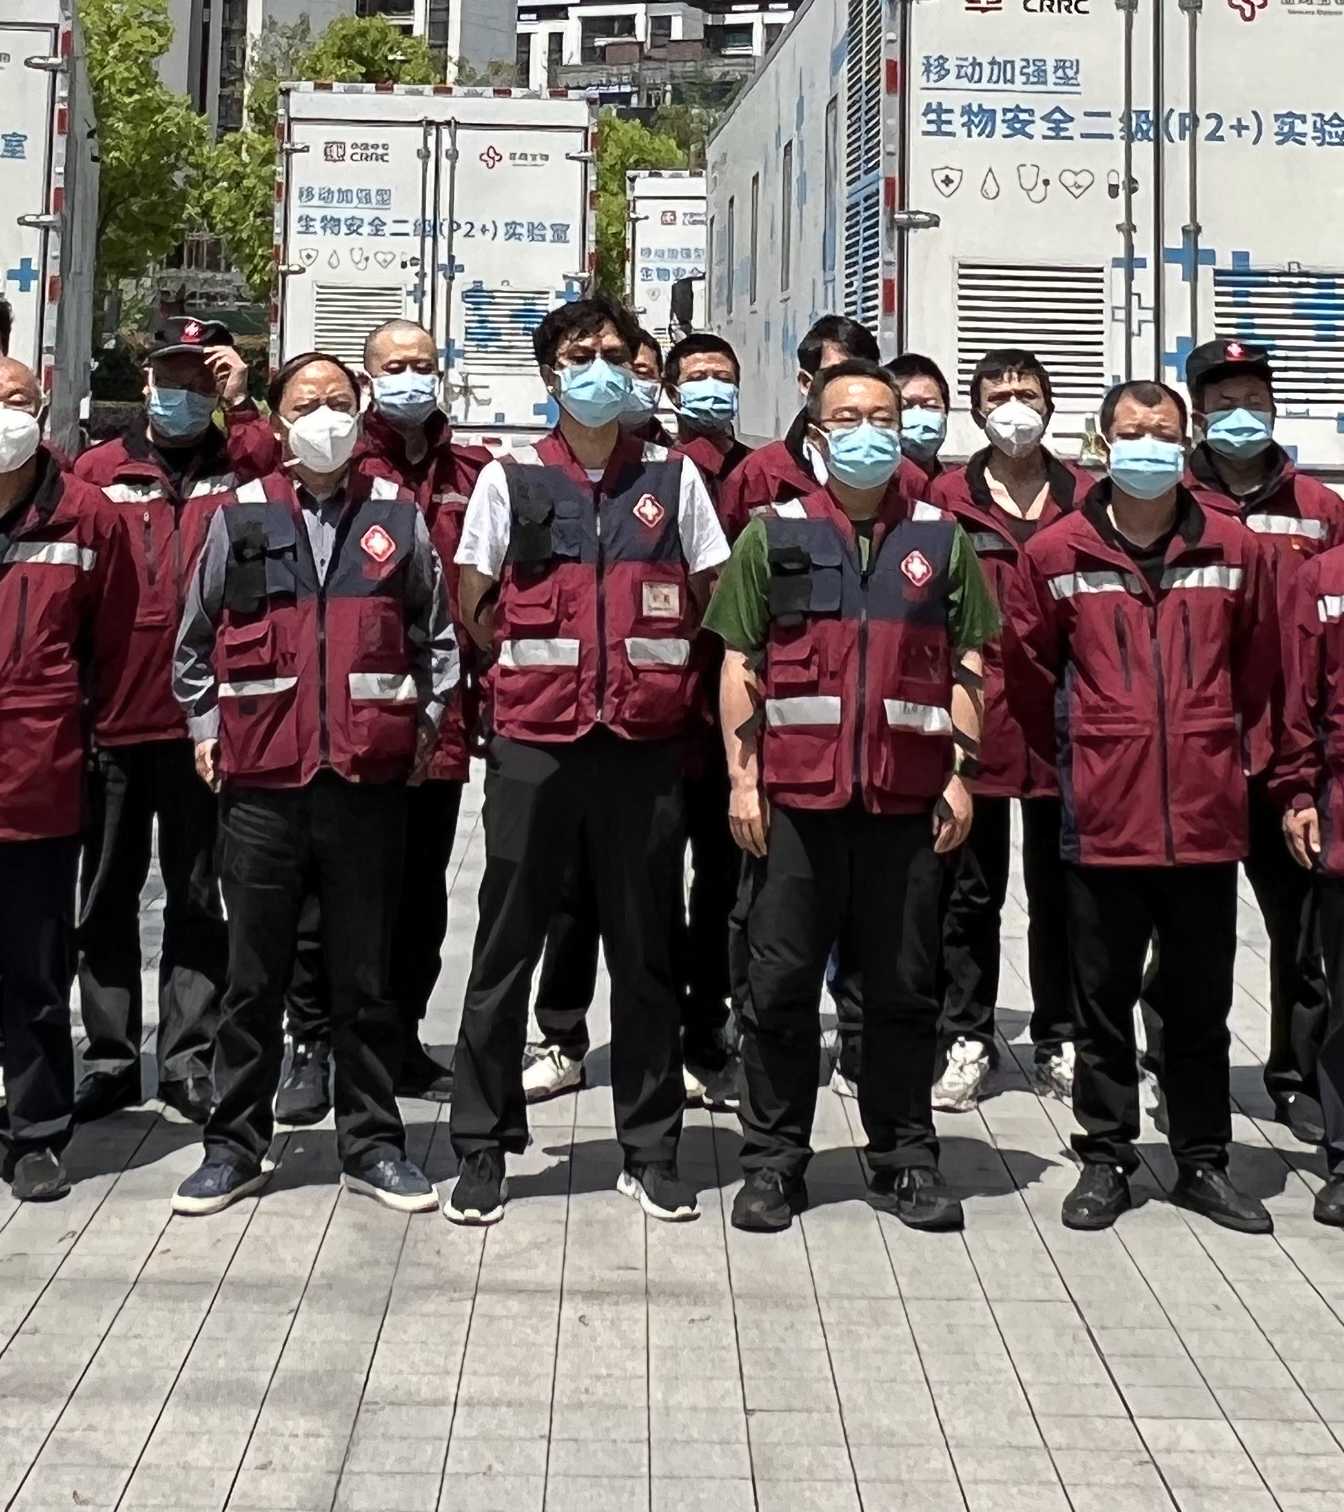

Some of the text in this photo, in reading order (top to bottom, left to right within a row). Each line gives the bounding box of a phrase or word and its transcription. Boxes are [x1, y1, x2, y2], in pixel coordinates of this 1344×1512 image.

[921, 54, 1081, 87] 移动加强型
